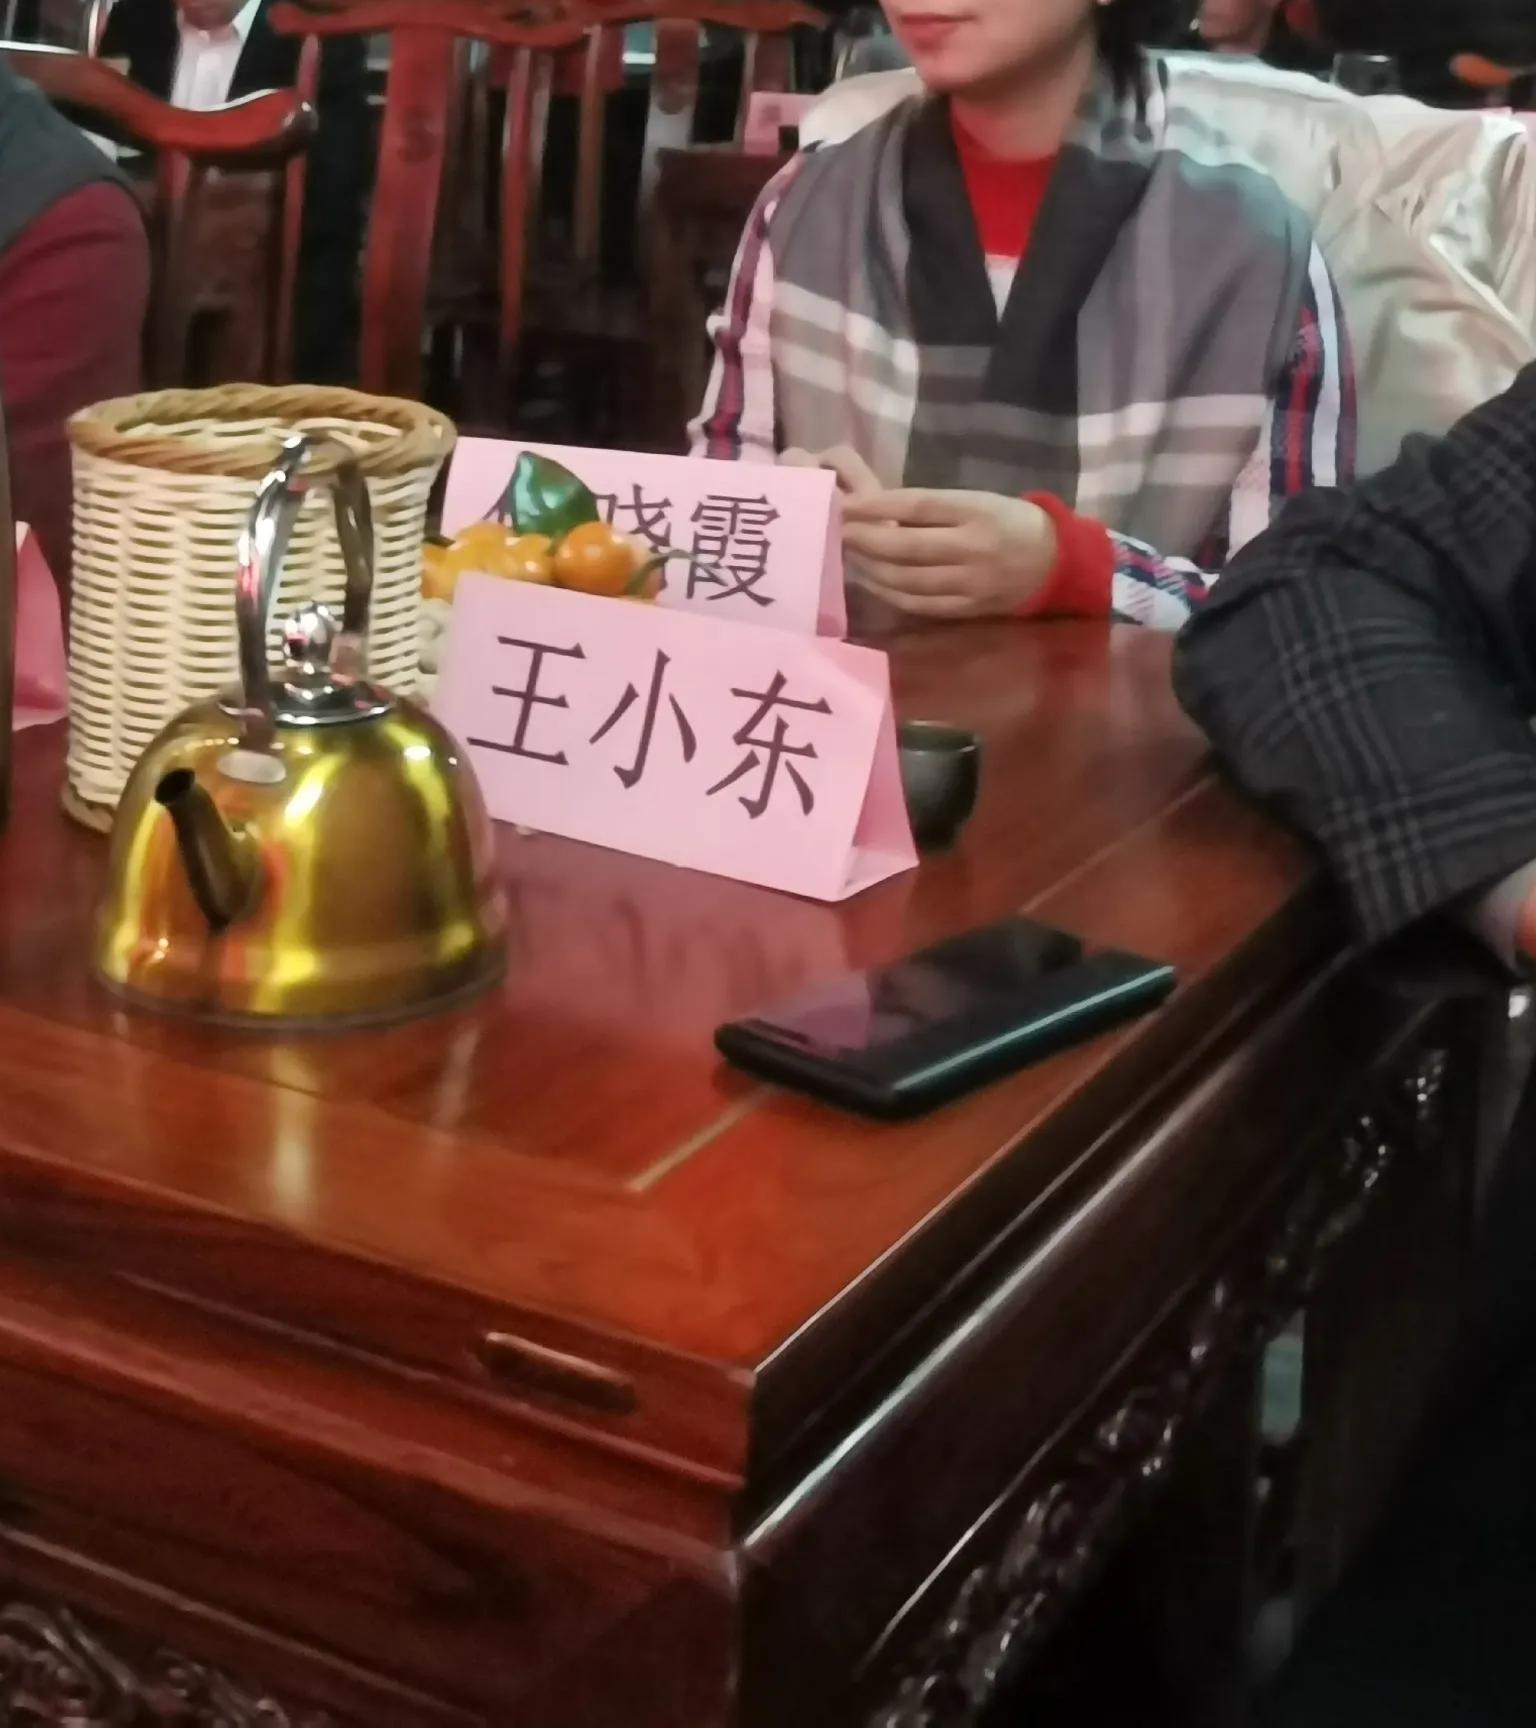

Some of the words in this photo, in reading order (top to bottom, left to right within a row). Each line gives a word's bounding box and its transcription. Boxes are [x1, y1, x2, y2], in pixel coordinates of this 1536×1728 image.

[482, 482, 781, 608] 晓霞
[465, 634, 834, 820] 王小东
